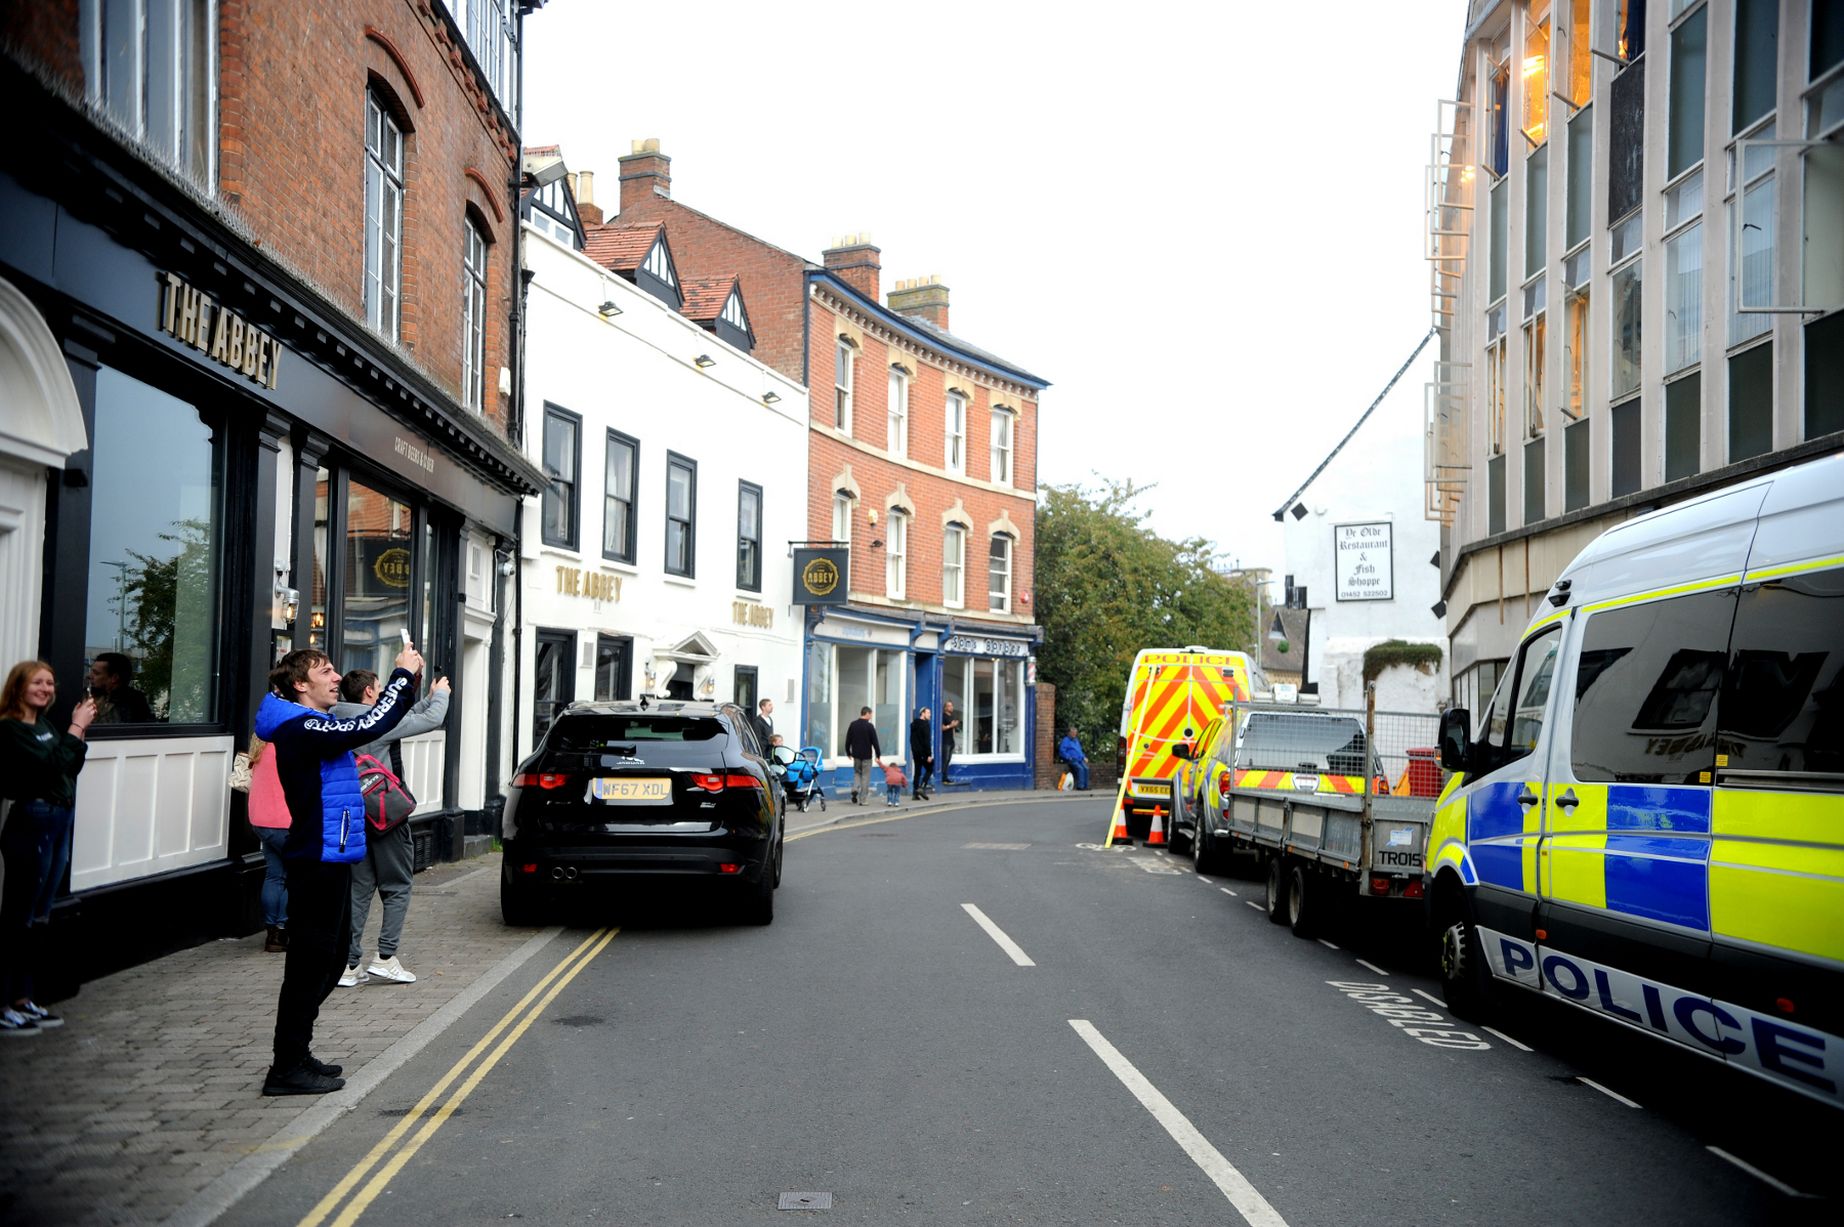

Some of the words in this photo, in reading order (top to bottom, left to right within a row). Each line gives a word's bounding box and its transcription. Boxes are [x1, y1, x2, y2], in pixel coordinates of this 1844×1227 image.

[165, 271, 212, 353] THE
[211, 305, 283, 390] ABBEY
[1360, 527, 1381, 537] Olde
[1340, 540, 1388, 551] Restaurant
[1360, 552, 1367, 561] &
[1353, 564, 1376, 576] Fish
[807, 572, 834, 583] ABBEY
[1348, 576, 1381, 587] Shoppe
[556, 565, 581, 597] THE
[582, 571, 622, 604] ABBEY
[732, 601, 748, 626] THE
[748, 604, 774, 629] ABBEY
[603, 783, 637, 796] WF67
[642, 783, 667, 796] XDL
[1325, 980, 1492, 1050] DISABLED
[1499, 937, 1838, 1095] POLICE
